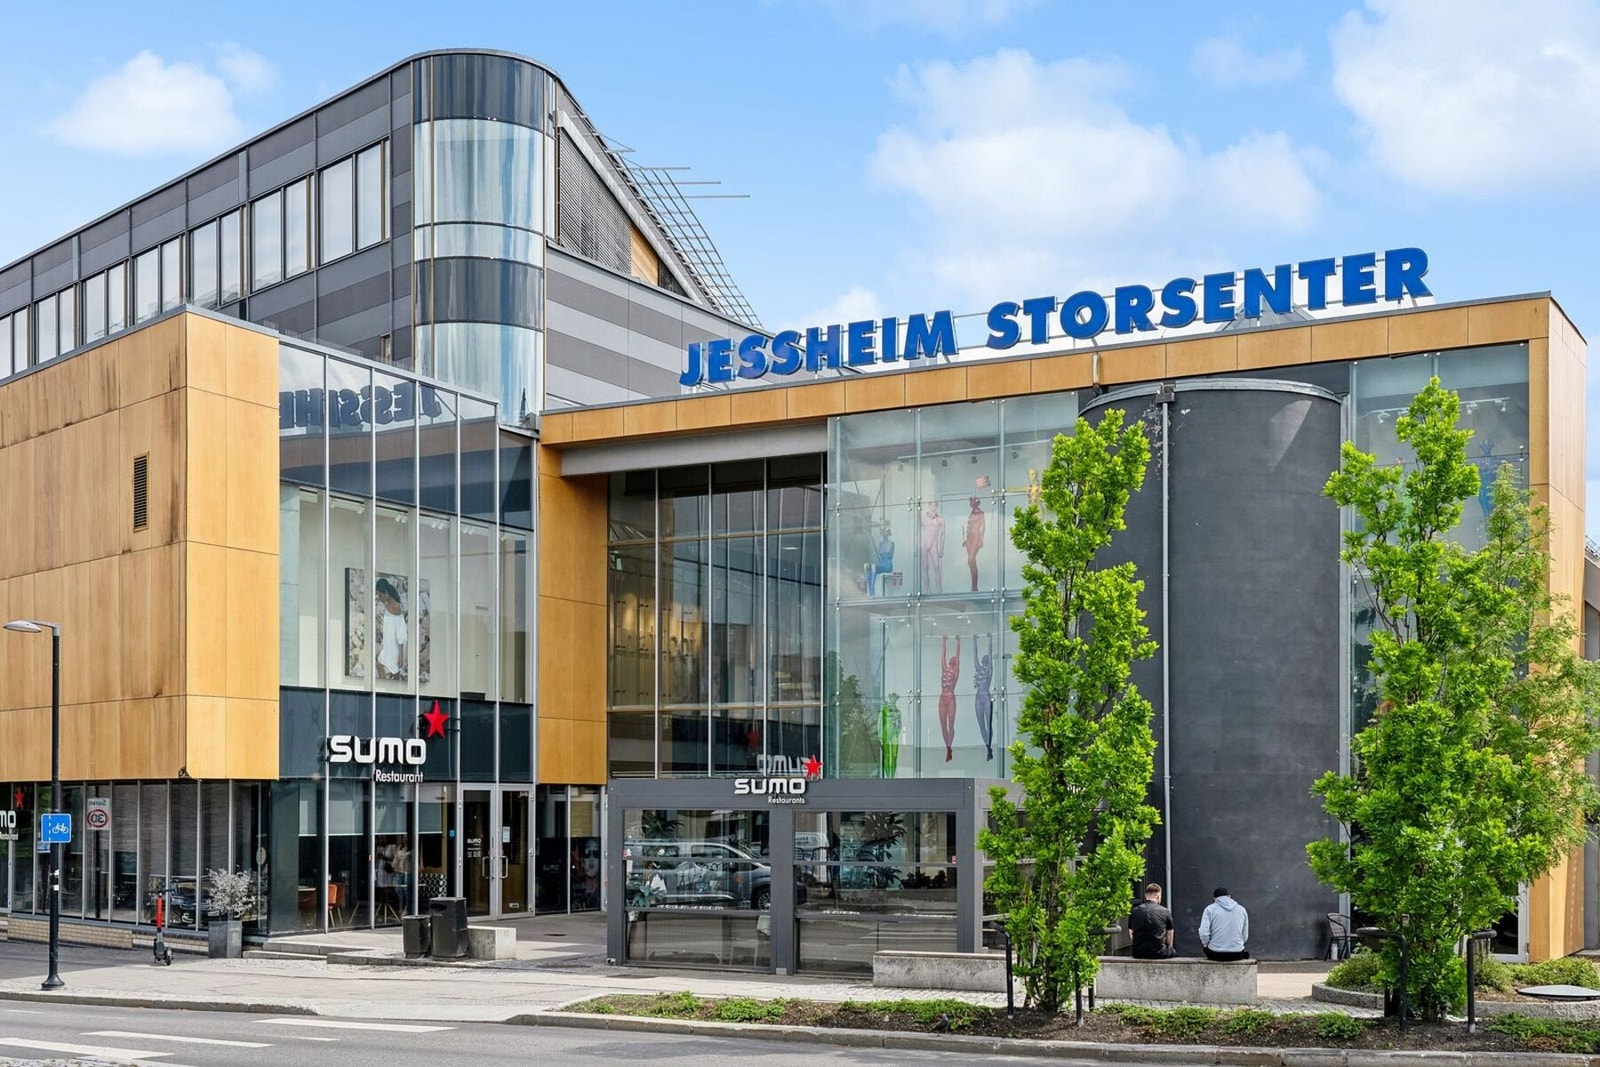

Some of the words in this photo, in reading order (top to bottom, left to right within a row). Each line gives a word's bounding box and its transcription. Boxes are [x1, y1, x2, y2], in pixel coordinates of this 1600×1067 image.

[679, 310, 958, 387] JESSHEIM
[986, 247, 1433, 350] STORSENTER
[330, 735, 427, 765] SUMO
[375, 769, 424, 783] Restaurant
[734, 778, 806, 794] SUMO
[768, 795, 806, 804] Restaurants
